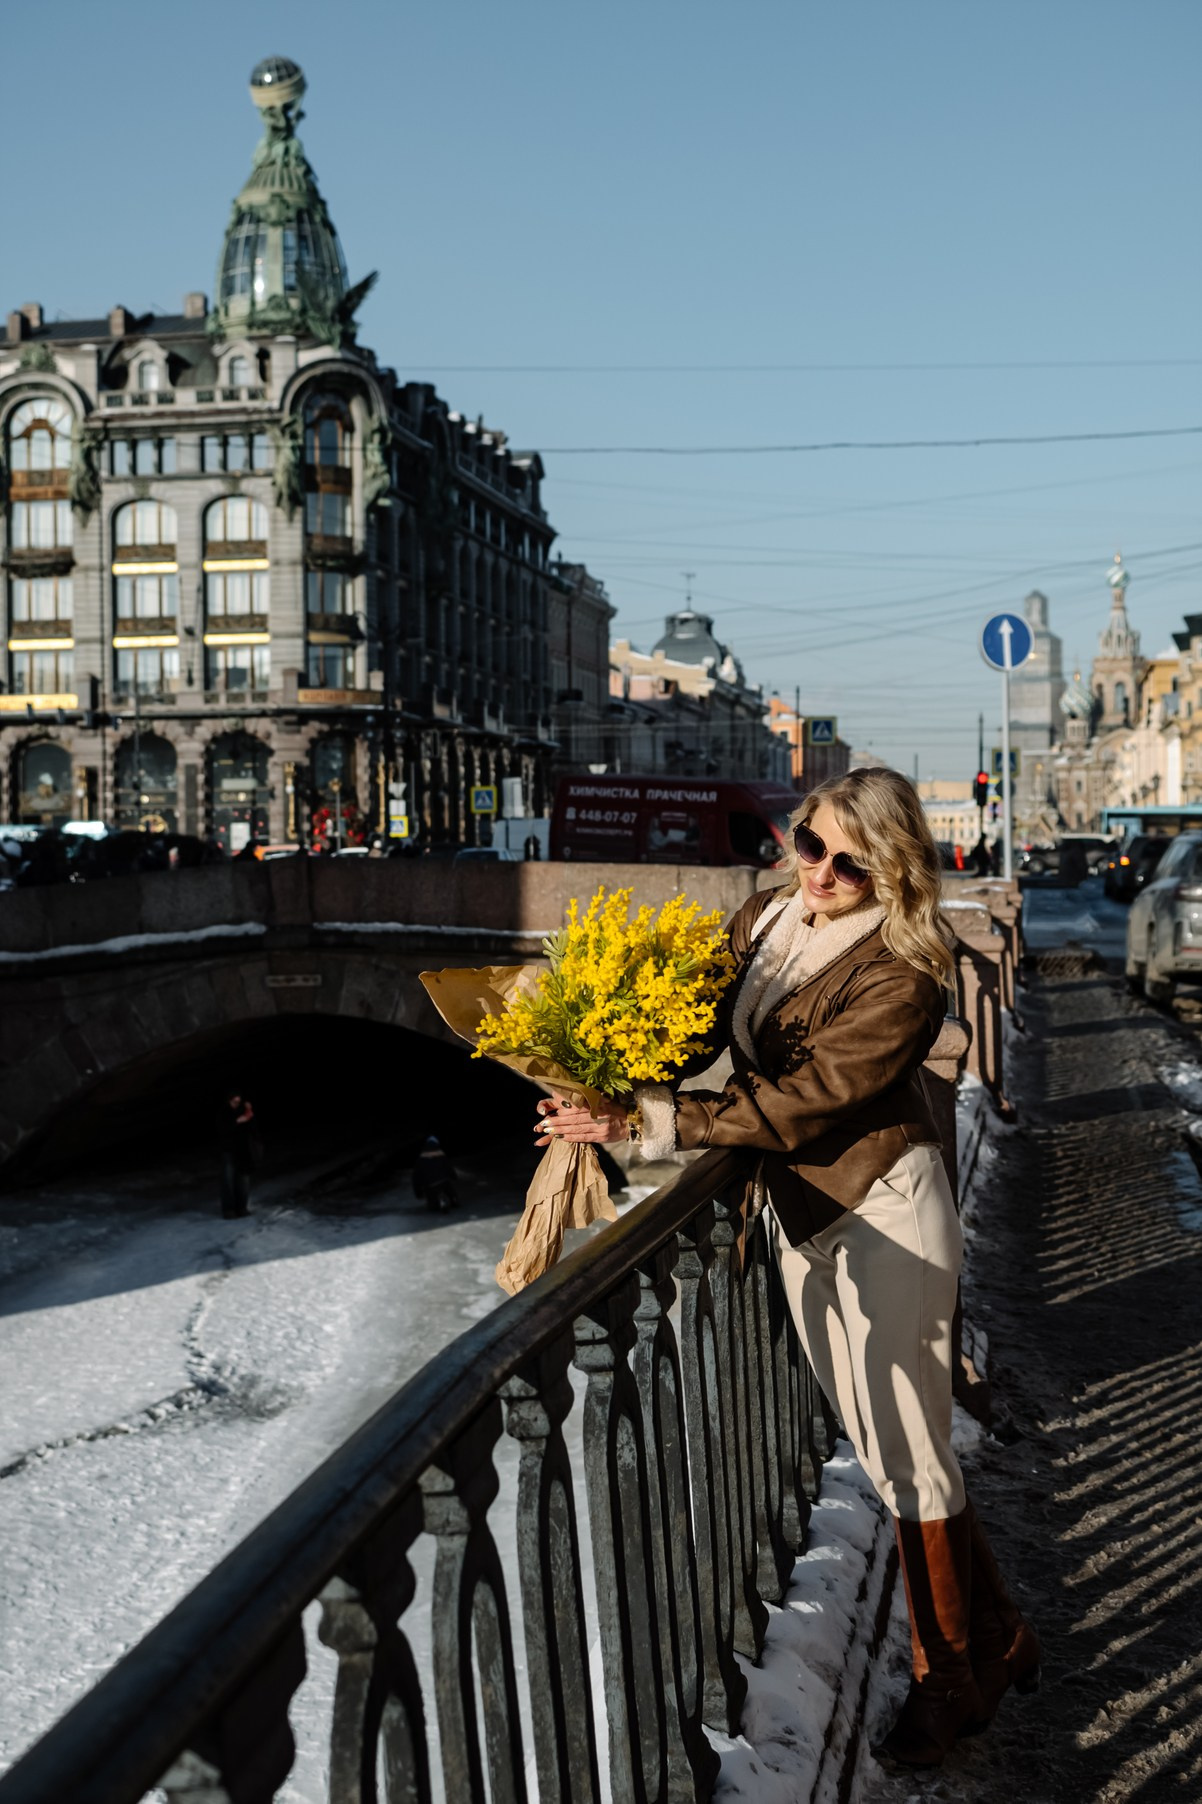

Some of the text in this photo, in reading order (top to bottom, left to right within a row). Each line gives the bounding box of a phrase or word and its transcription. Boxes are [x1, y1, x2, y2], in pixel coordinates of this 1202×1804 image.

[569, 785, 718, 802] ХИМЧИСТКА ПРАЧЕЧНАЯ
[578, 809, 638, 824] 448-07-07
